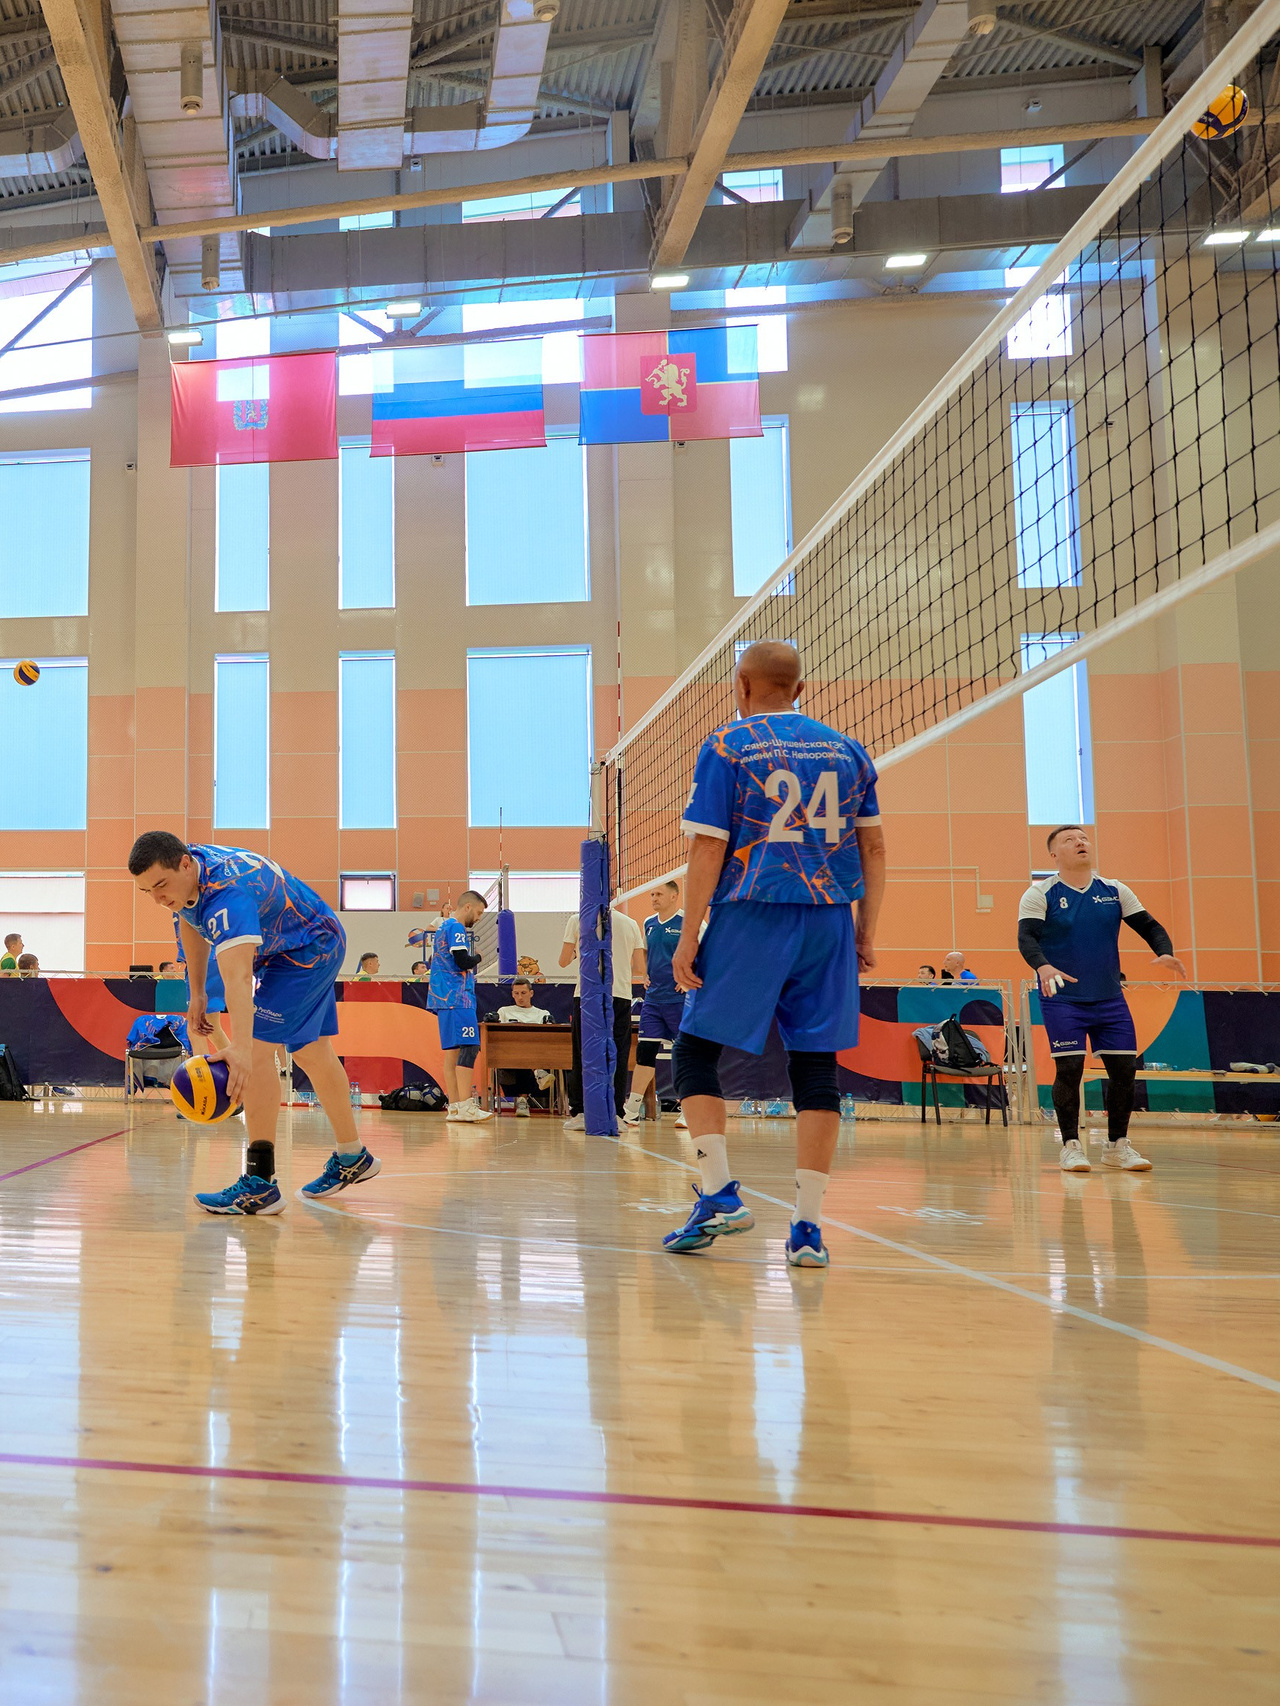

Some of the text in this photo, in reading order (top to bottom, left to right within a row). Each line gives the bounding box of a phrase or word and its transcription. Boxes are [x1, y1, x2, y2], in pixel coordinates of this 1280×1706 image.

[764, 769, 847, 843] 24
[1060, 897, 1069, 909] 8
[207, 907, 230, 940] 27
[462, 1026, 475, 1038] 28
